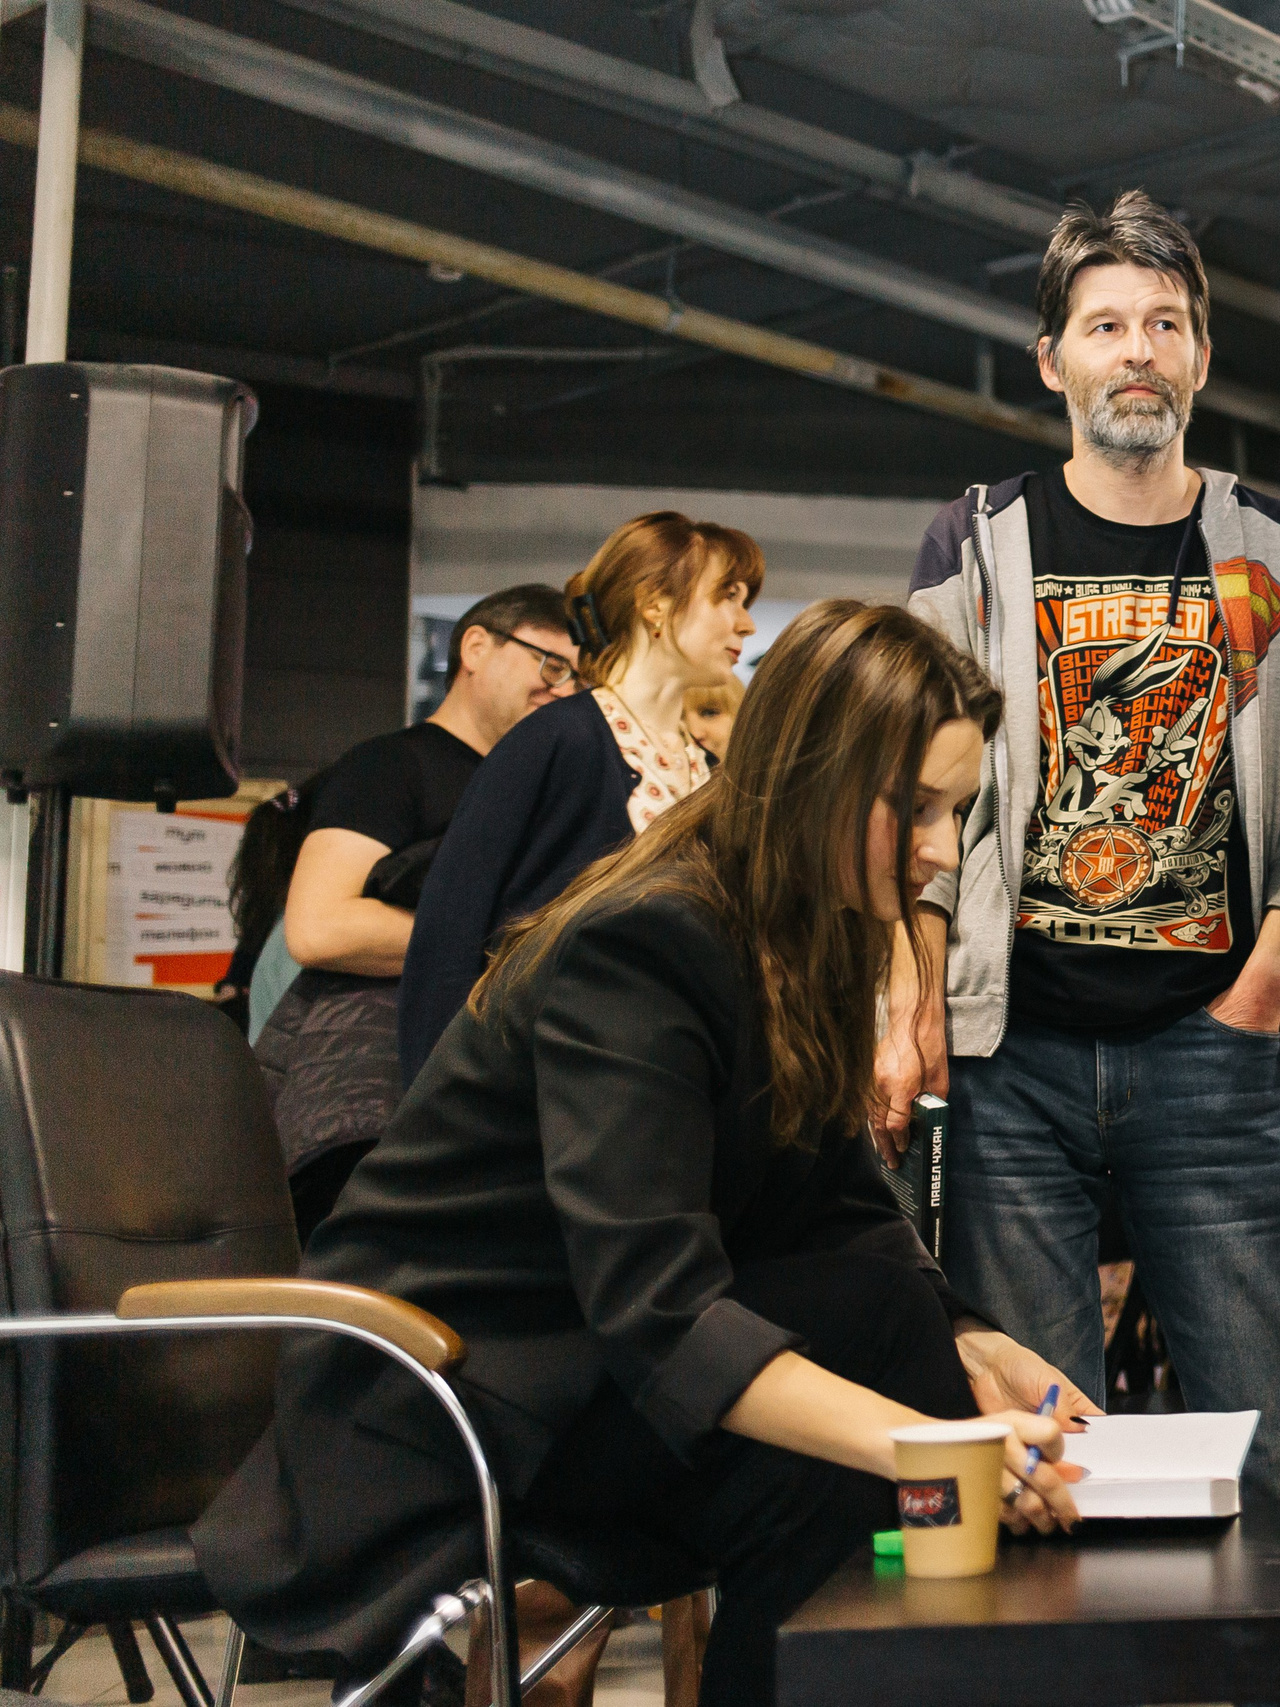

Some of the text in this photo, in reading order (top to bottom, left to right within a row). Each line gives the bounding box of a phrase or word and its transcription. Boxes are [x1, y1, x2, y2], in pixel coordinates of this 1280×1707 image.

[1035, 581, 1063, 598] BUNNY
[1132, 695, 1193, 716] BUNN
[930, 1125, 943, 1207] ПАВЕЛ ЧЖАН
